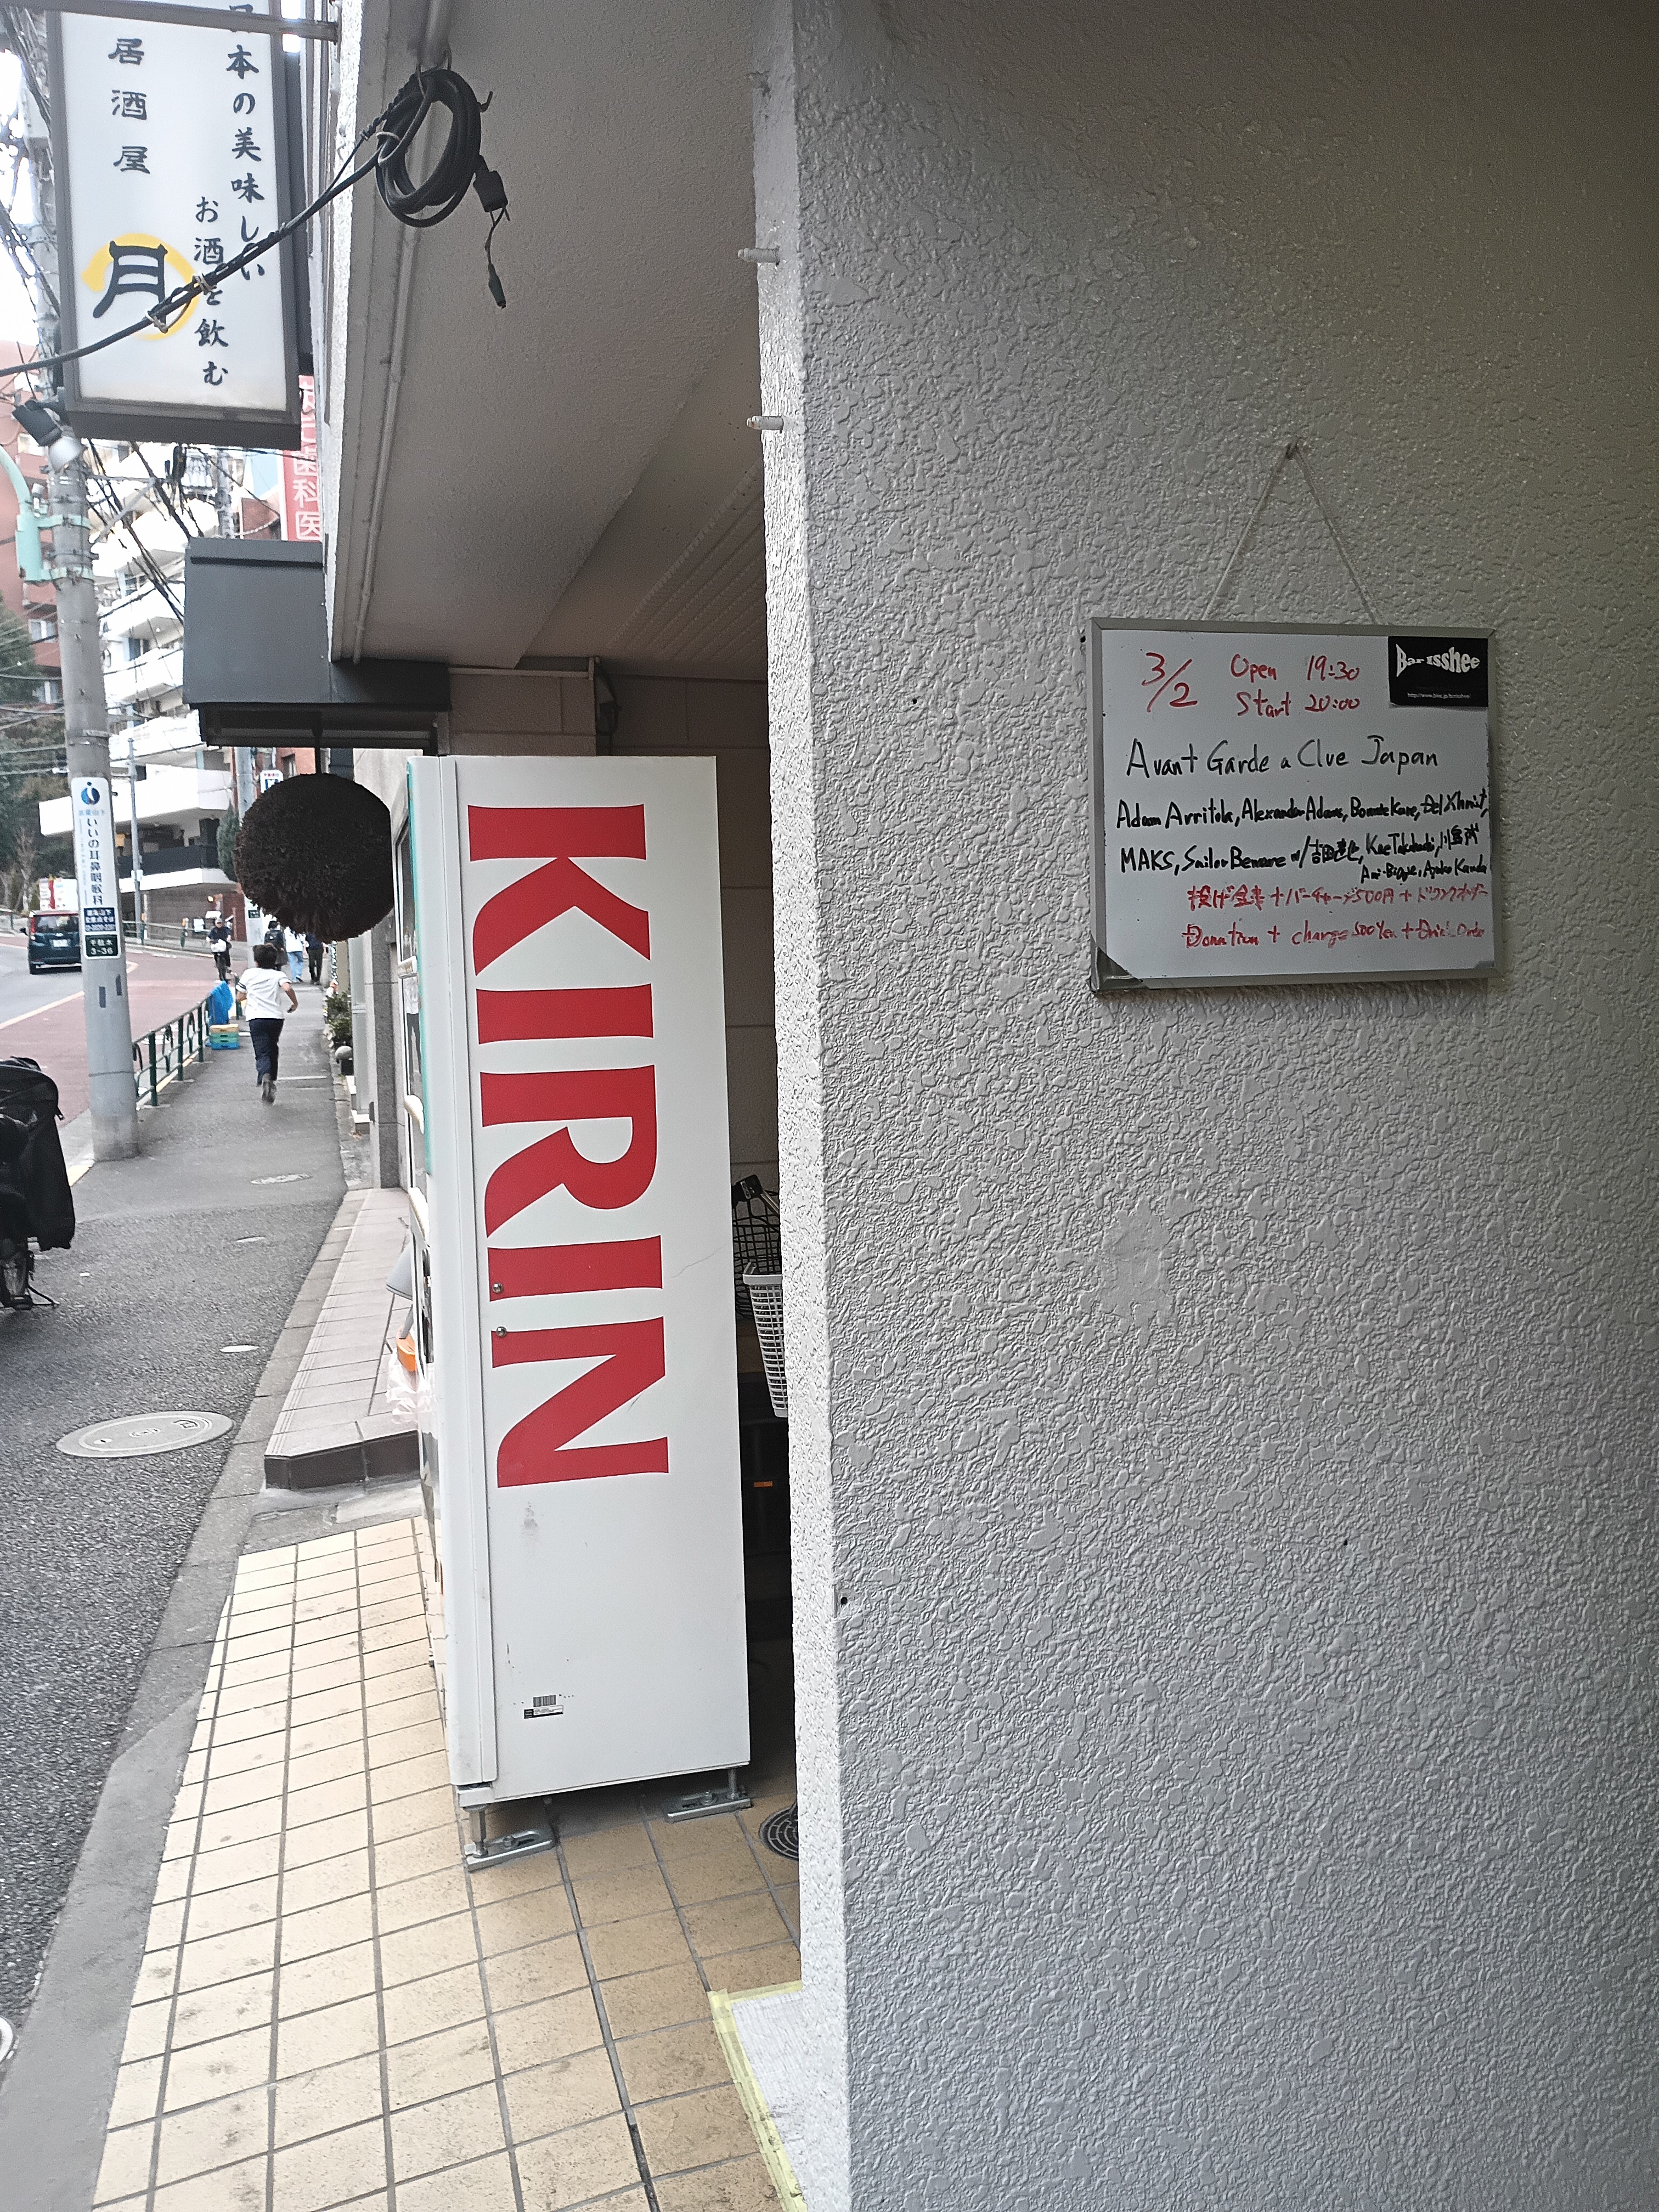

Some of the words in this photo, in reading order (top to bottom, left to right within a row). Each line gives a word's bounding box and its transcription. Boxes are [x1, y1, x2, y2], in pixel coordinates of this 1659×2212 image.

[108, 38, 150, 174] 居酒屋
[93, 240, 168, 324] 月
[1141, 652, 1198, 713] 3/2
[1231, 653, 1277, 682] Open
[1307, 655, 1360, 681] 19:30
[1396, 644, 1425, 677] Bar
[1236, 689, 1291, 718] Start
[1305, 694, 1361, 712] 20:00
[1126, 738, 1198, 778] Avant
[1207, 740, 1269, 775] Garde
[1280, 757, 1291, 769] a
[1361, 735, 1438, 775] Japan
[468, 803, 669, 1489] KIRIN
